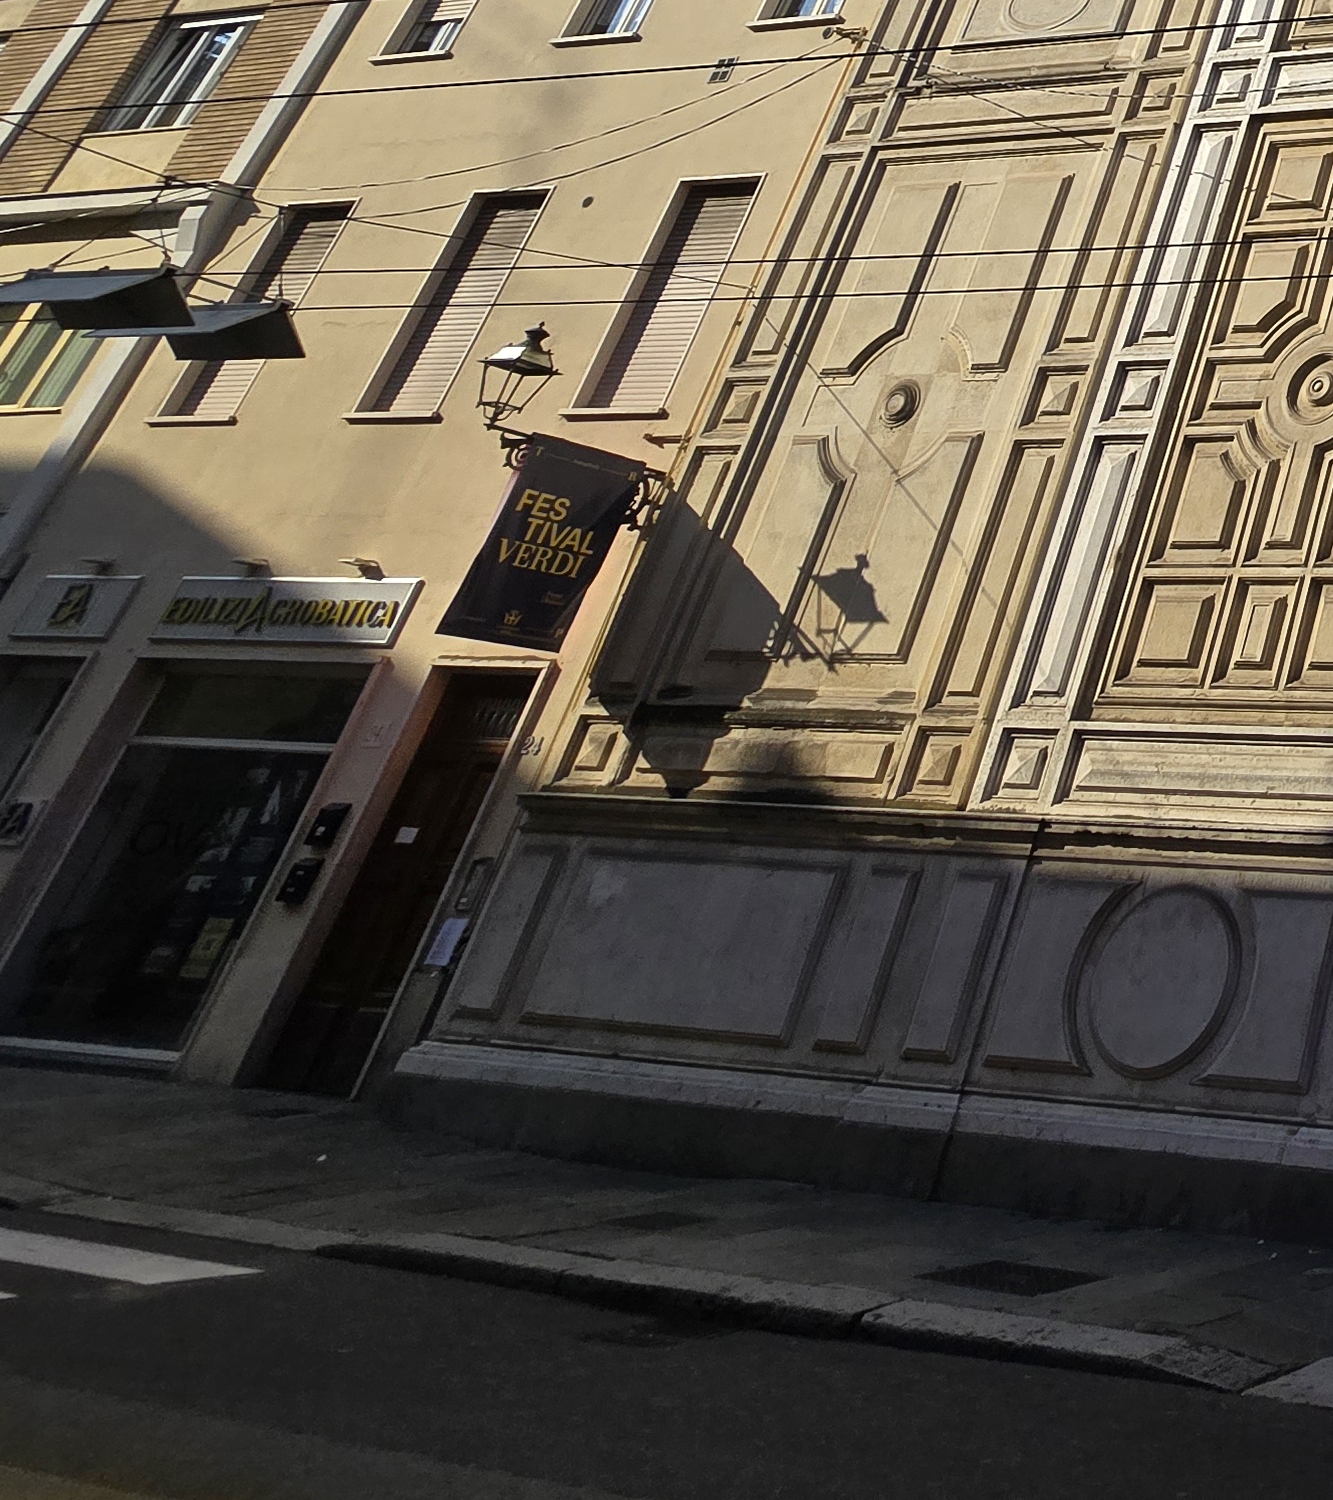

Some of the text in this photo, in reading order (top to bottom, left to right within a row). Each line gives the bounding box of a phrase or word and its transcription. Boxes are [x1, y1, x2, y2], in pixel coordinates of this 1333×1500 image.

[515, 488, 570, 521] FES
[524, 517, 595, 555] TIVAL
[497, 538, 588, 579] VERDI
[520, 735, 544, 757] 24
